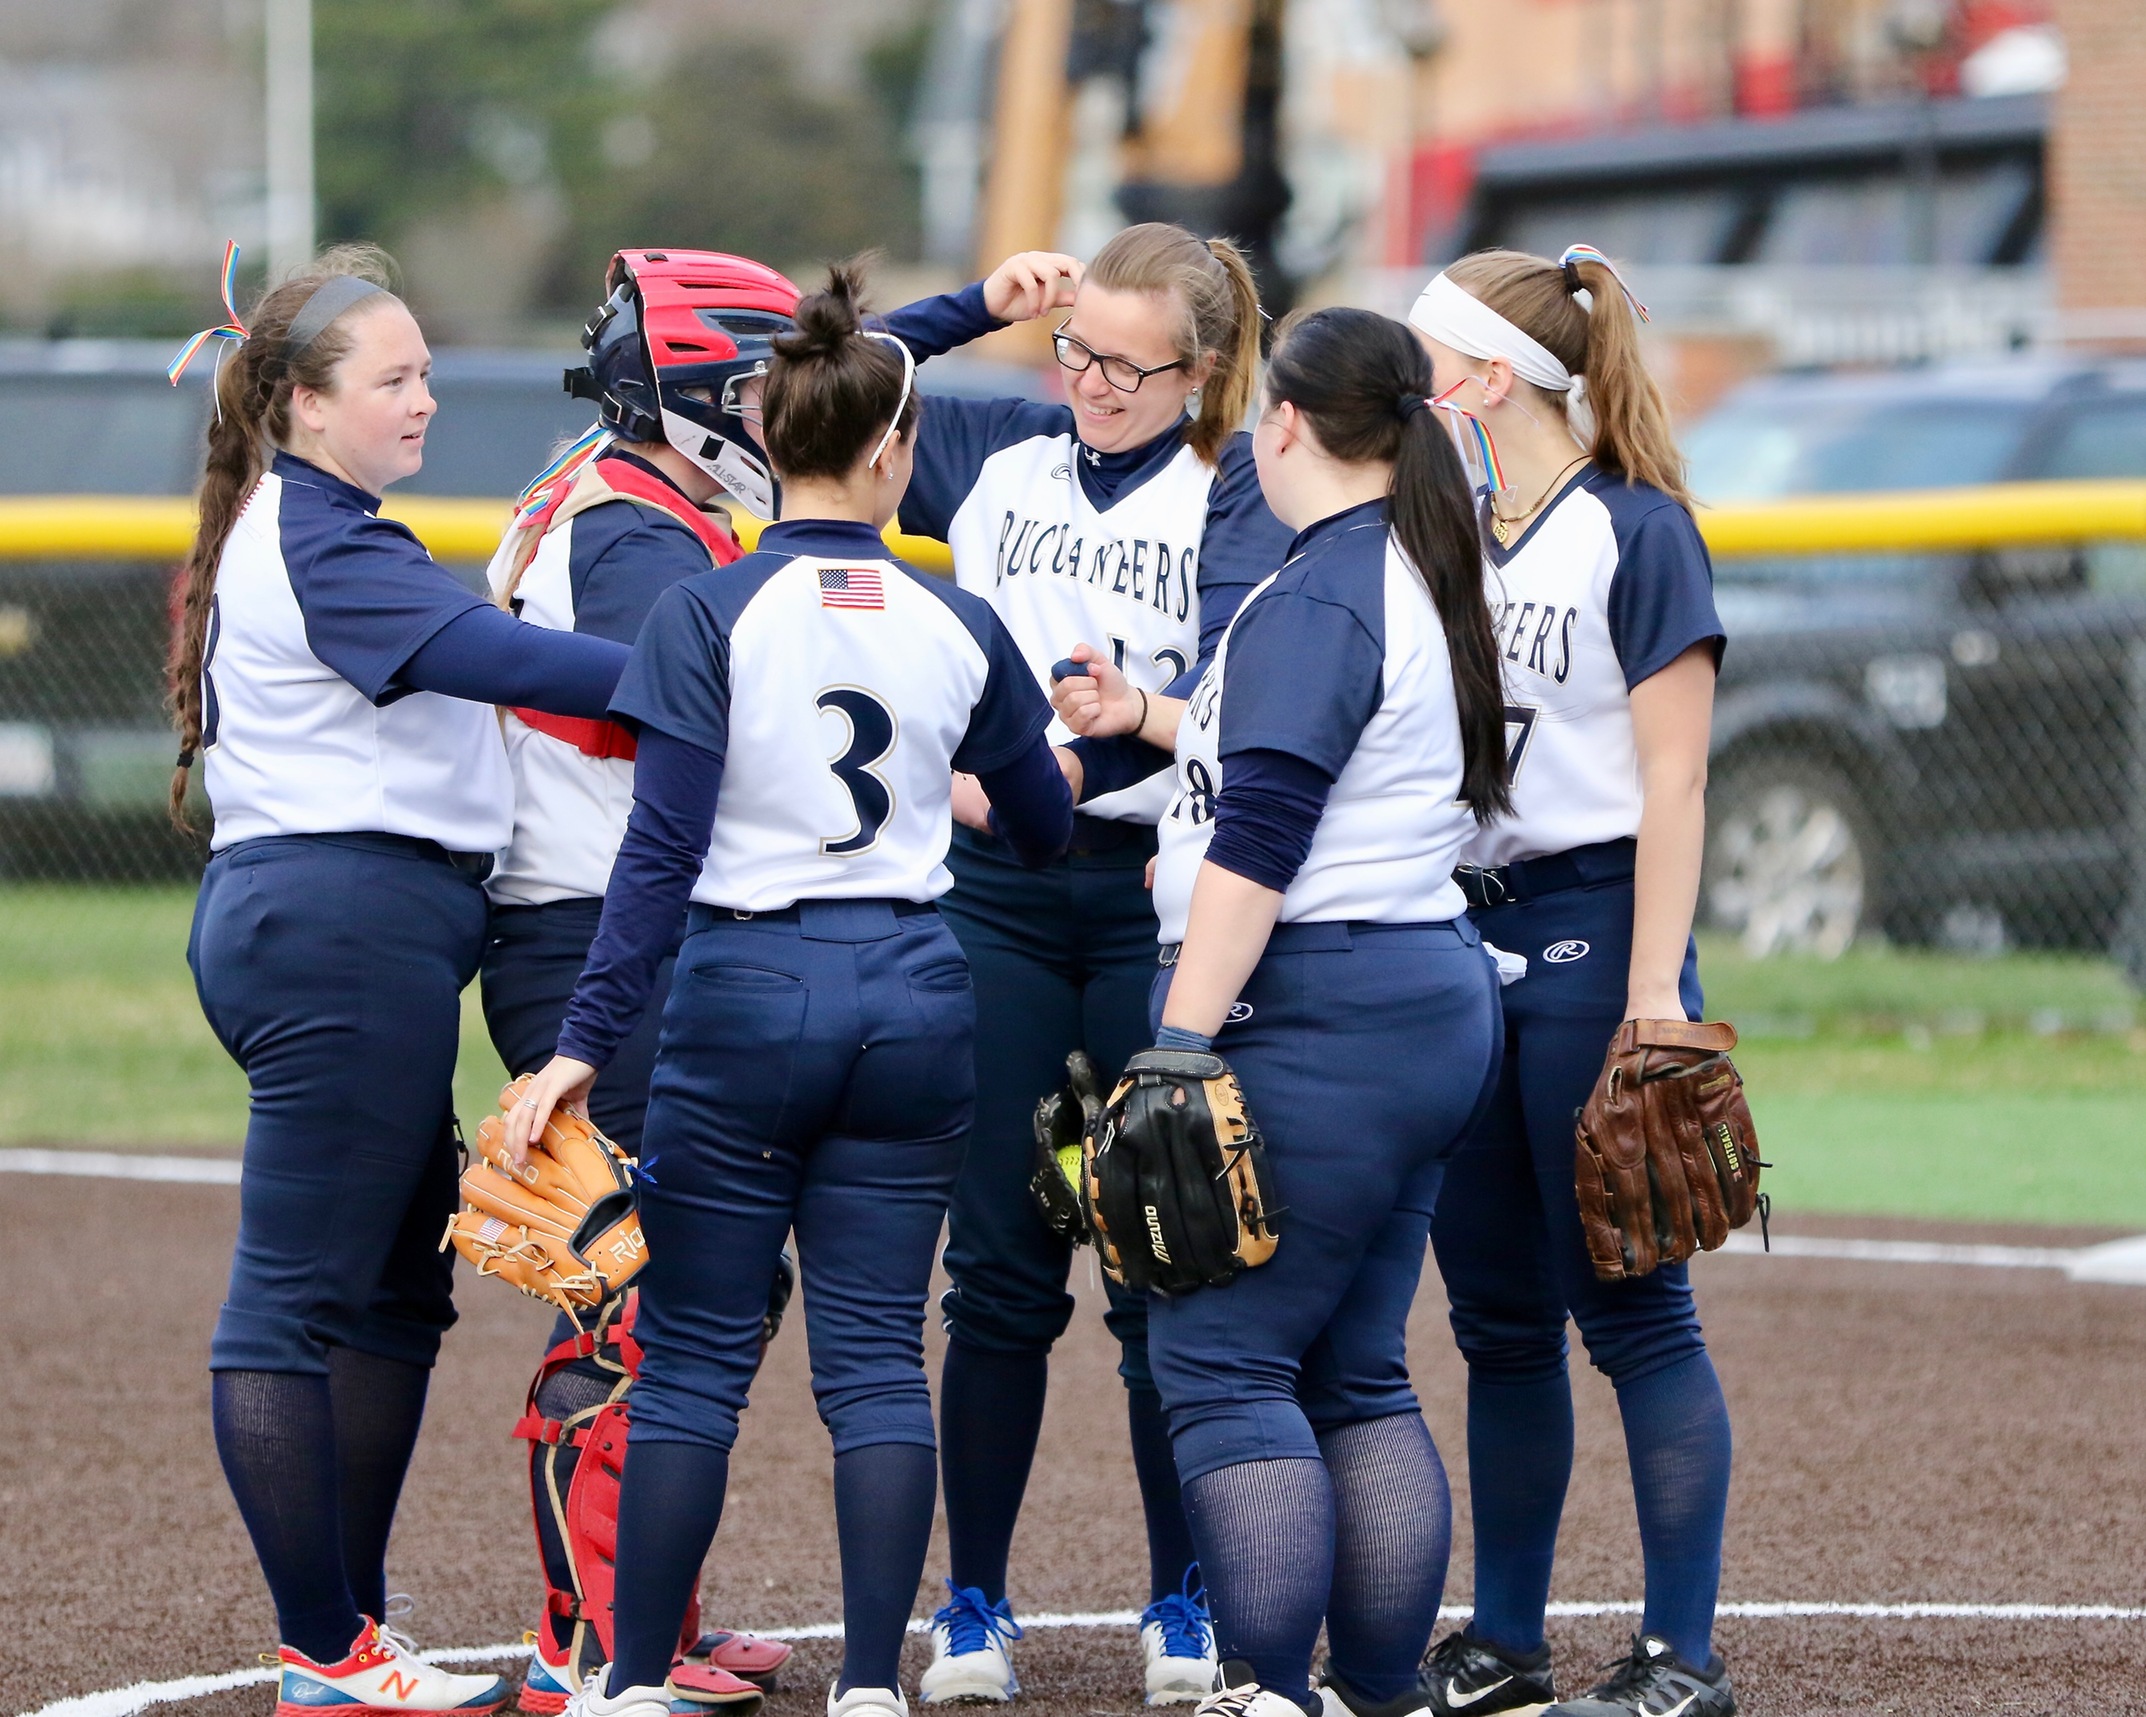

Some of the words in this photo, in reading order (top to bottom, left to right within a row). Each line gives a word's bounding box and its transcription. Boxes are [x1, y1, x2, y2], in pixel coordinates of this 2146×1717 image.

[815, 688, 895, 854] 3
[1717, 1123, 1740, 1170] SOFTBALL
[1144, 1205, 1172, 1265] MIZUNO
